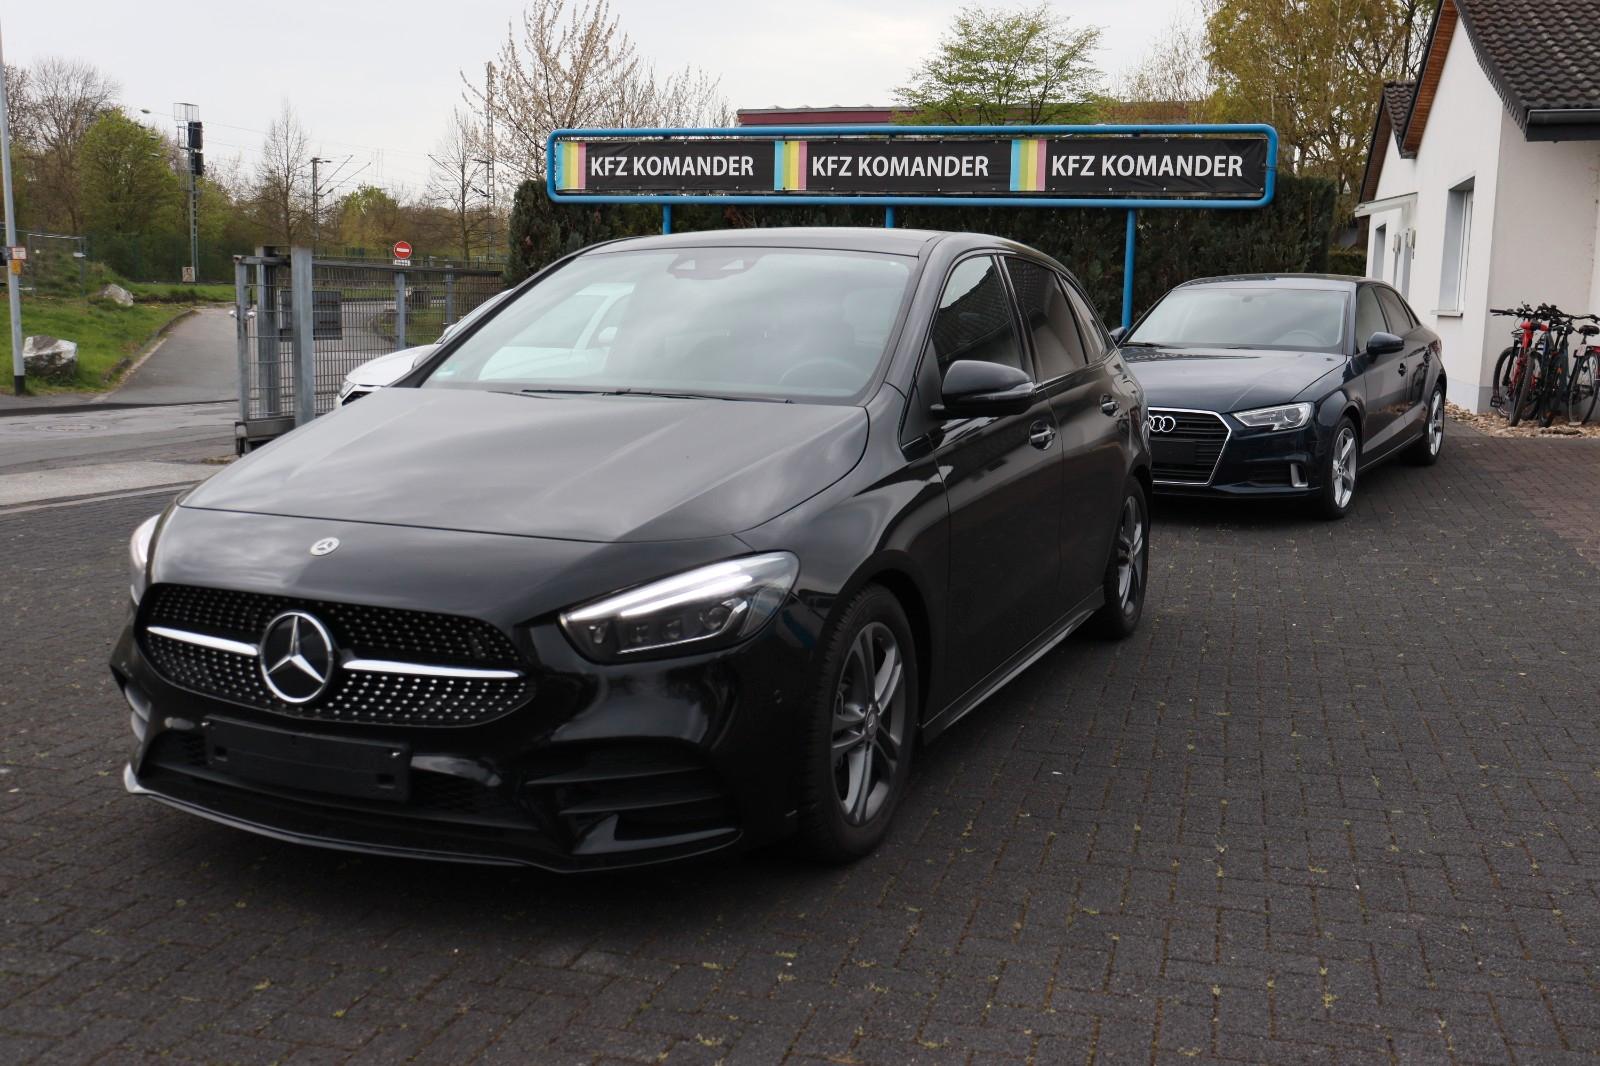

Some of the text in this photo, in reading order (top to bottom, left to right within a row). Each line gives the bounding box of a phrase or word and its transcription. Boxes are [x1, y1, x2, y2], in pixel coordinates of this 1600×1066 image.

[591, 155, 754, 177] KFZ KOMANDER
[812, 155, 989, 177] KFZ KOMANDER
[1051, 155, 1243, 177] KFZ KOMANDER
